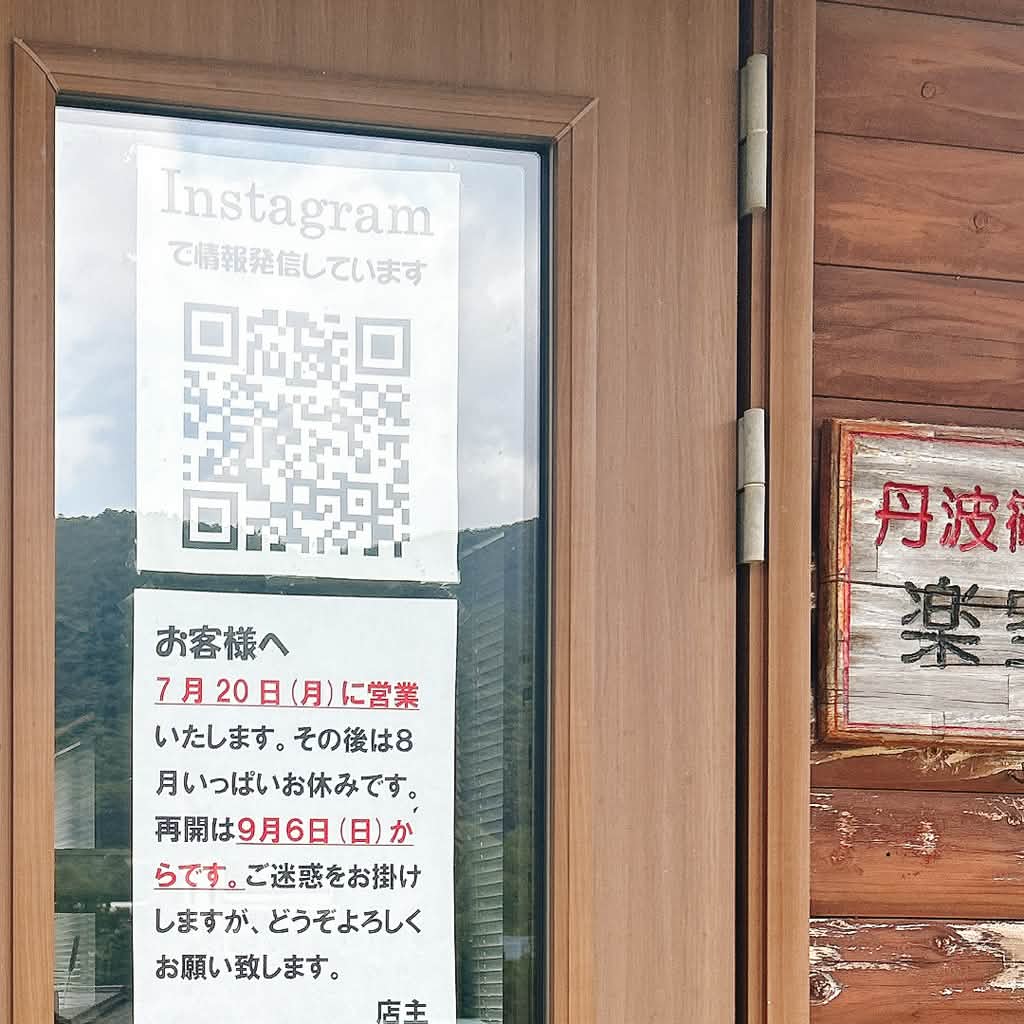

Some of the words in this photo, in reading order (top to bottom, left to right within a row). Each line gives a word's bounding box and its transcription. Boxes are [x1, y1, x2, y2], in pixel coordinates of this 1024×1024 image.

[160, 167, 435, 240] Instagram
[167, 239, 428, 287] で情報発信しています
[155, 624, 290, 661] お客様へ
[155, 724, 414, 754] いたします。その後は8
[155, 770, 417, 800] 月いっぱいお休みです。
[155, 861, 422, 891] らです。ご迷惑をお掛け
[155, 908, 422, 935] しますが、どうぞよろしく
[155, 953, 342, 981] お願い致します。
